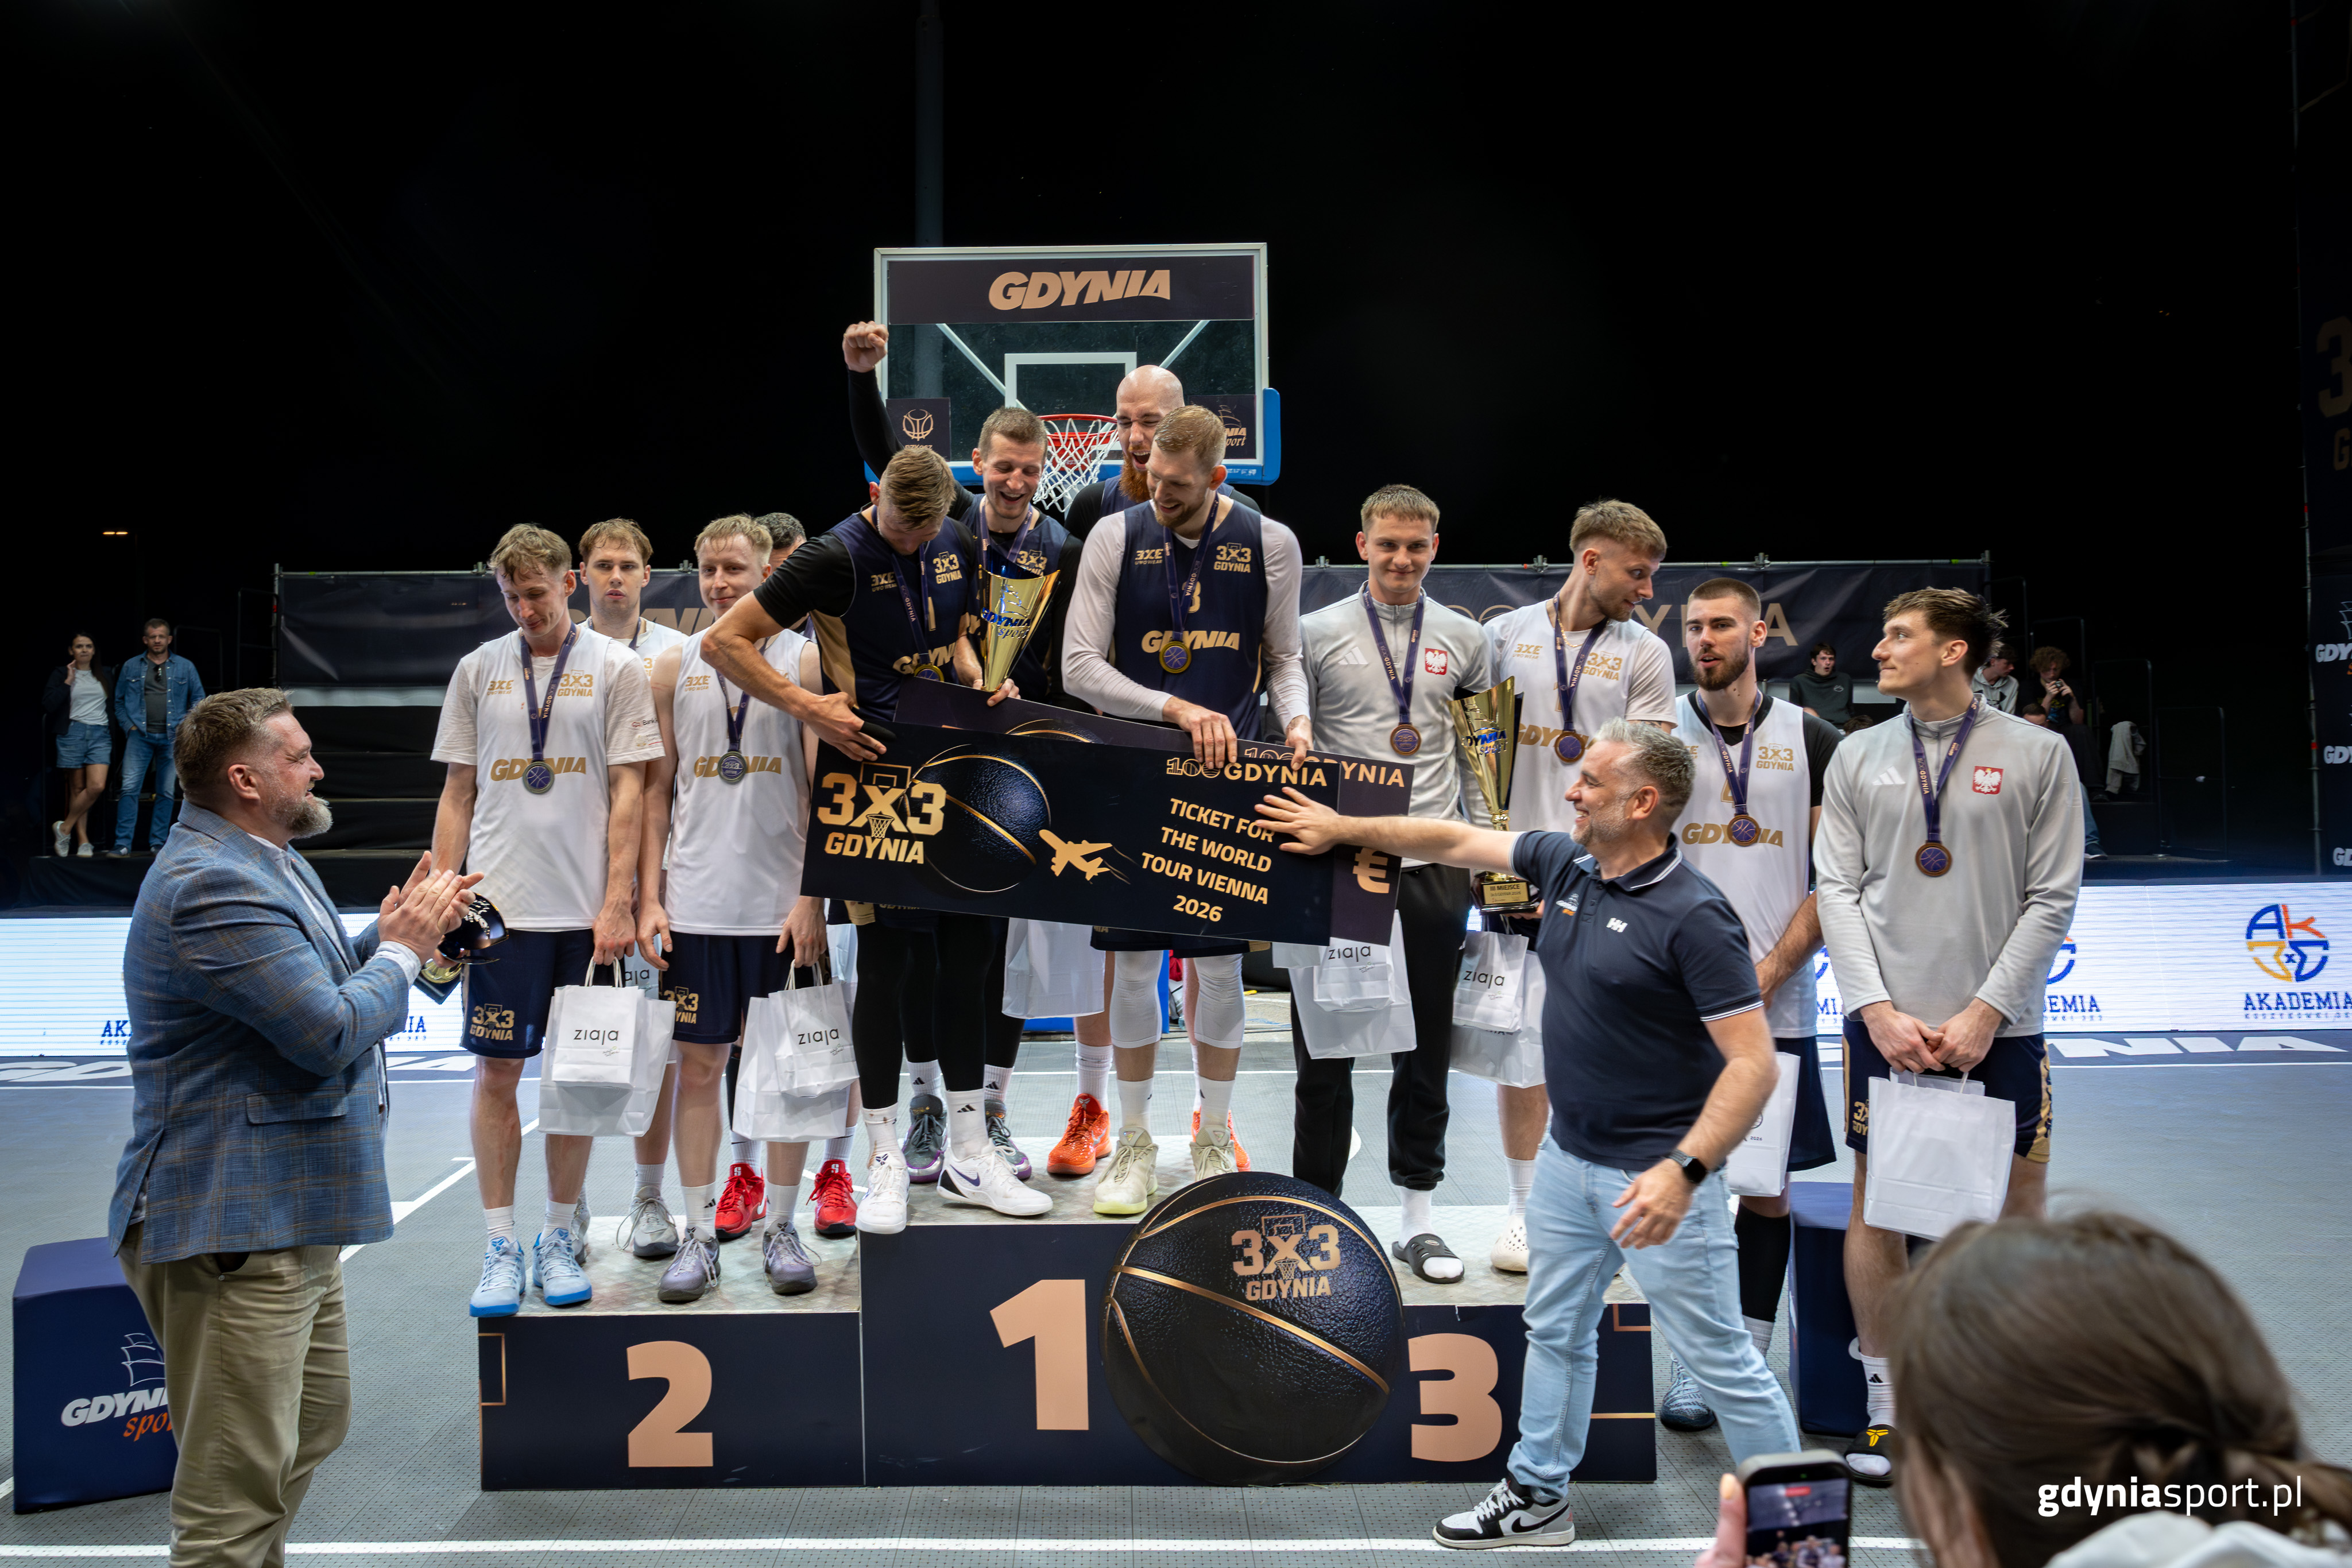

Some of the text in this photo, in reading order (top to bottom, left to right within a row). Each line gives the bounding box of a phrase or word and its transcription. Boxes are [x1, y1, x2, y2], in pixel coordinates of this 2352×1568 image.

[988, 269, 1171, 310] GDYNIA
[1225, 428, 1247, 436] NIA
[1226, 436, 1247, 447] port
[933, 553, 960, 574] 3X3
[1216, 545, 1252, 562] 3X3
[935, 570, 962, 584] GDYNIA
[1213, 561, 1251, 573] GDYNIA
[1185, 573, 1197, 597] GDYNIA
[904, 598, 916, 622] GDYNIA
[981, 607, 1032, 628] GDYNIA
[893, 642, 957, 675] GYNI
[1587, 653, 1623, 671] 3X3
[2315, 643, 2352, 663] GDY
[1384, 657, 1396, 680] GDYNIA
[1570, 665, 1581, 688] GDYNIA
[1581, 665, 1619, 681] GDYNIA
[560, 673, 594, 687] 3X3
[557, 688, 593, 697] GDYNIA
[543, 695, 553, 719] GDYNIA
[1722, 751, 1733, 773] GDYNIA
[1758, 746, 1793, 761] 3X3
[694, 756, 782, 778] GDNIA
[1224, 762, 1327, 787] GDYNIA
[1304, 756, 1405, 787] YNIA
[1756, 761, 1794, 772] GDYNIA
[1920, 770, 1930, 795] GDYNIA
[817, 772, 947, 836] 3X3
[1170, 797, 1235, 830] TICKET
[1681, 822, 1784, 848] GDYIA
[824, 832, 924, 864] GDYNIA
[1160, 826, 1272, 873] THE WORLD
[1142, 852, 1269, 905] TOUR VIENNA
[1173, 895, 1224, 923] 2026
[1328, 944, 1371, 963] ziaja
[625, 969, 649, 984] aja
[1463, 970, 1505, 989] ziaja
[2044, 995, 2100, 1012] EMIA
[2244, 992, 2352, 1010] AKADEMIA
[472, 1005, 515, 1029] 3X3
[675, 1011, 697, 1024] YNIA
[470, 1024, 514, 1041] GDYNIA
[574, 1029, 619, 1046] ziaja
[798, 1028, 840, 1045] ziaja
[2050, 1036, 2349, 1058] NIA
[1854, 1101, 1869, 1121] 3X
[1852, 1121, 1868, 1136] GDY
[1231, 1225, 1341, 1276] 3X3
[1245, 1276, 1332, 1301] GDYNIA
[989, 1279, 1089, 1430] 1
[61, 1387, 168, 1427] GDYNI
[626, 1341, 713, 1468] 2
[1407, 1333, 1503, 1462] 3
[123, 1412, 172, 1442] spo
